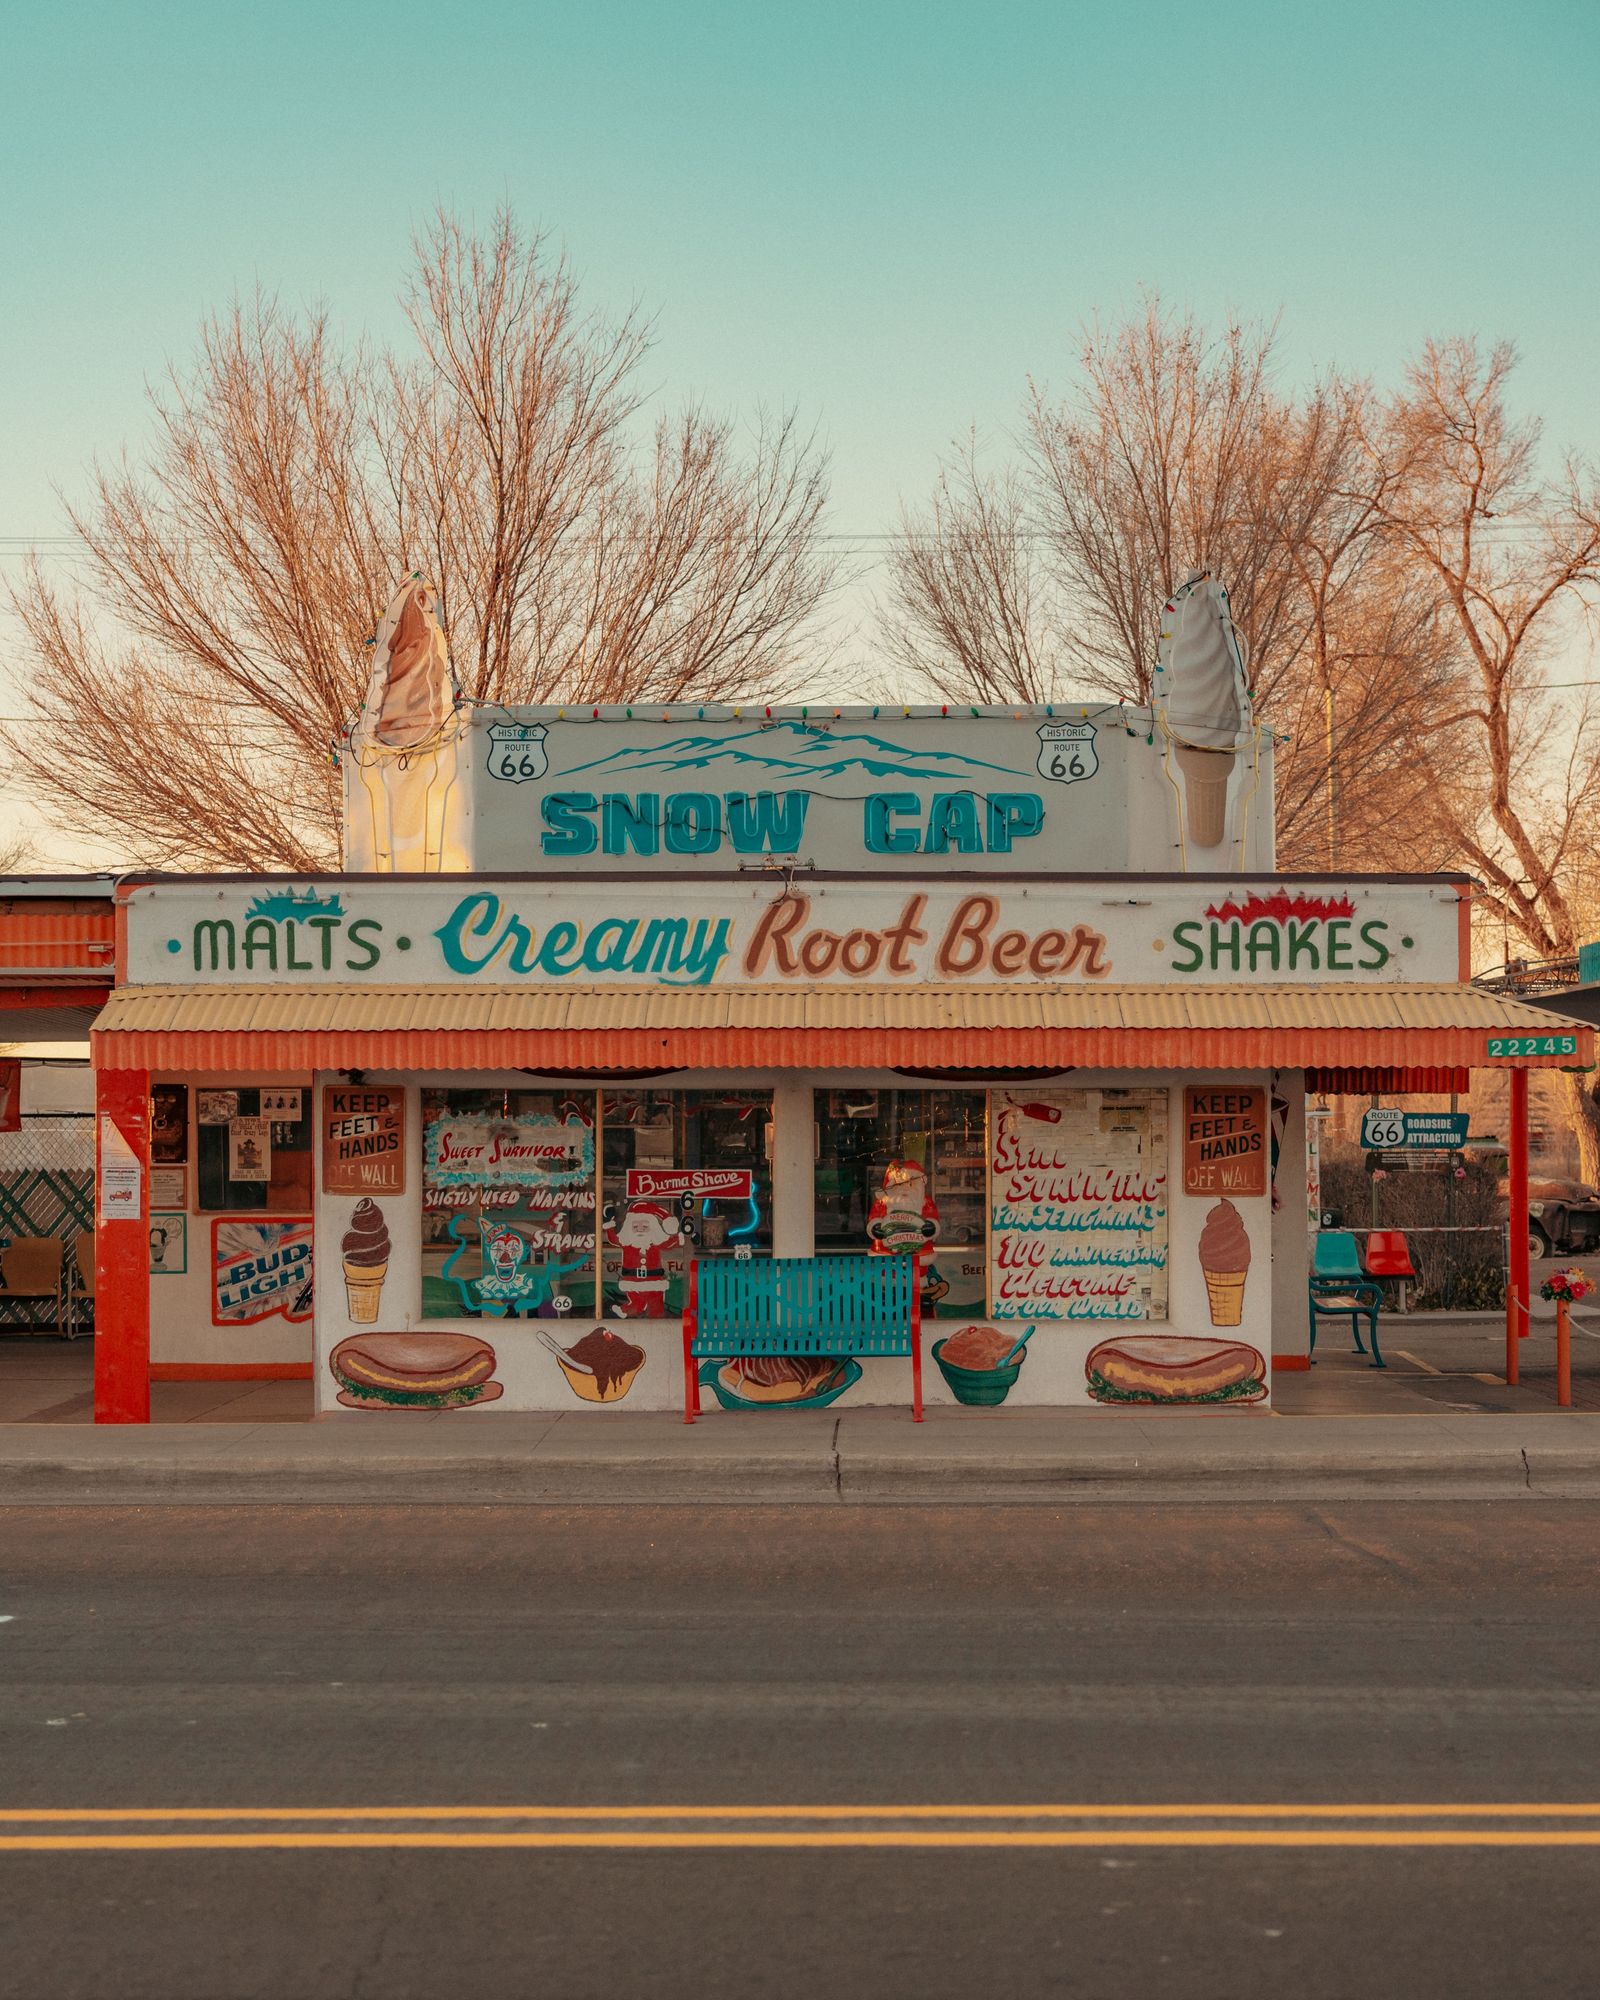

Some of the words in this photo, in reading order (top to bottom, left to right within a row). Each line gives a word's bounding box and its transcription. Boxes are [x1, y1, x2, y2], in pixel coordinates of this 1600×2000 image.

[498, 728, 537, 738] HISTORIC
[1047, 728, 1087, 737] HISTORIC
[504, 743, 531, 752] ROUTE
[1053, 743, 1080, 752] ROUTE
[500, 754, 535, 777] 66
[1050, 754, 1085, 777] 66
[541, 790, 810, 856] SNOW
[864, 791, 1044, 854] CAP
[193, 918, 382, 971] MALTS
[433, 891, 734, 987] Creamy
[742, 890, 928, 980] Root
[935, 891, 1112, 980] Beer
[1171, 920, 1390, 973] SHAKES
[1491, 1037, 1573, 1056] 22245
[333, 1094, 390, 1113] KEEP
[1193, 1095, 1253, 1113] KEEP
[329, 1116, 379, 1139] FEET
[384, 1117, 400, 1129] &
[1190, 1117, 1237, 1141] FEET
[1242, 1119, 1257, 1131] &
[1371, 1122, 1398, 1142] 66
[1408, 1119, 1452, 1129] ROADSIDE
[1407, 1133, 1461, 1143] ATTRACTION
[340, 1132, 398, 1160] HANDS
[1201, 1133, 1261, 1161] HANDS
[360, 1164, 399, 1185] WALL
[636, 1174, 689, 1196] Burma
[691, 1171, 744, 1189] Shave
[1187, 1166, 1216, 1187] OFF
[1221, 1165, 1261, 1187] WALL
[480, 1189, 520, 1207] USED
[529, 1190, 596, 1210] NAPKINS
[889, 1212, 915, 1222] MERRY
[532, 1229, 596, 1253] STRAWS
[886, 1233, 926, 1245] CHRISTMAS
[998, 1235, 1046, 1269] 100
[230, 1243, 309, 1285] BUD
[220, 1264, 305, 1309] LIGH
[1000, 1270, 1137, 1299] WELCOME
[555, 1298, 571, 1309] 66
[1066, 1297, 1143, 1320] WORLD
